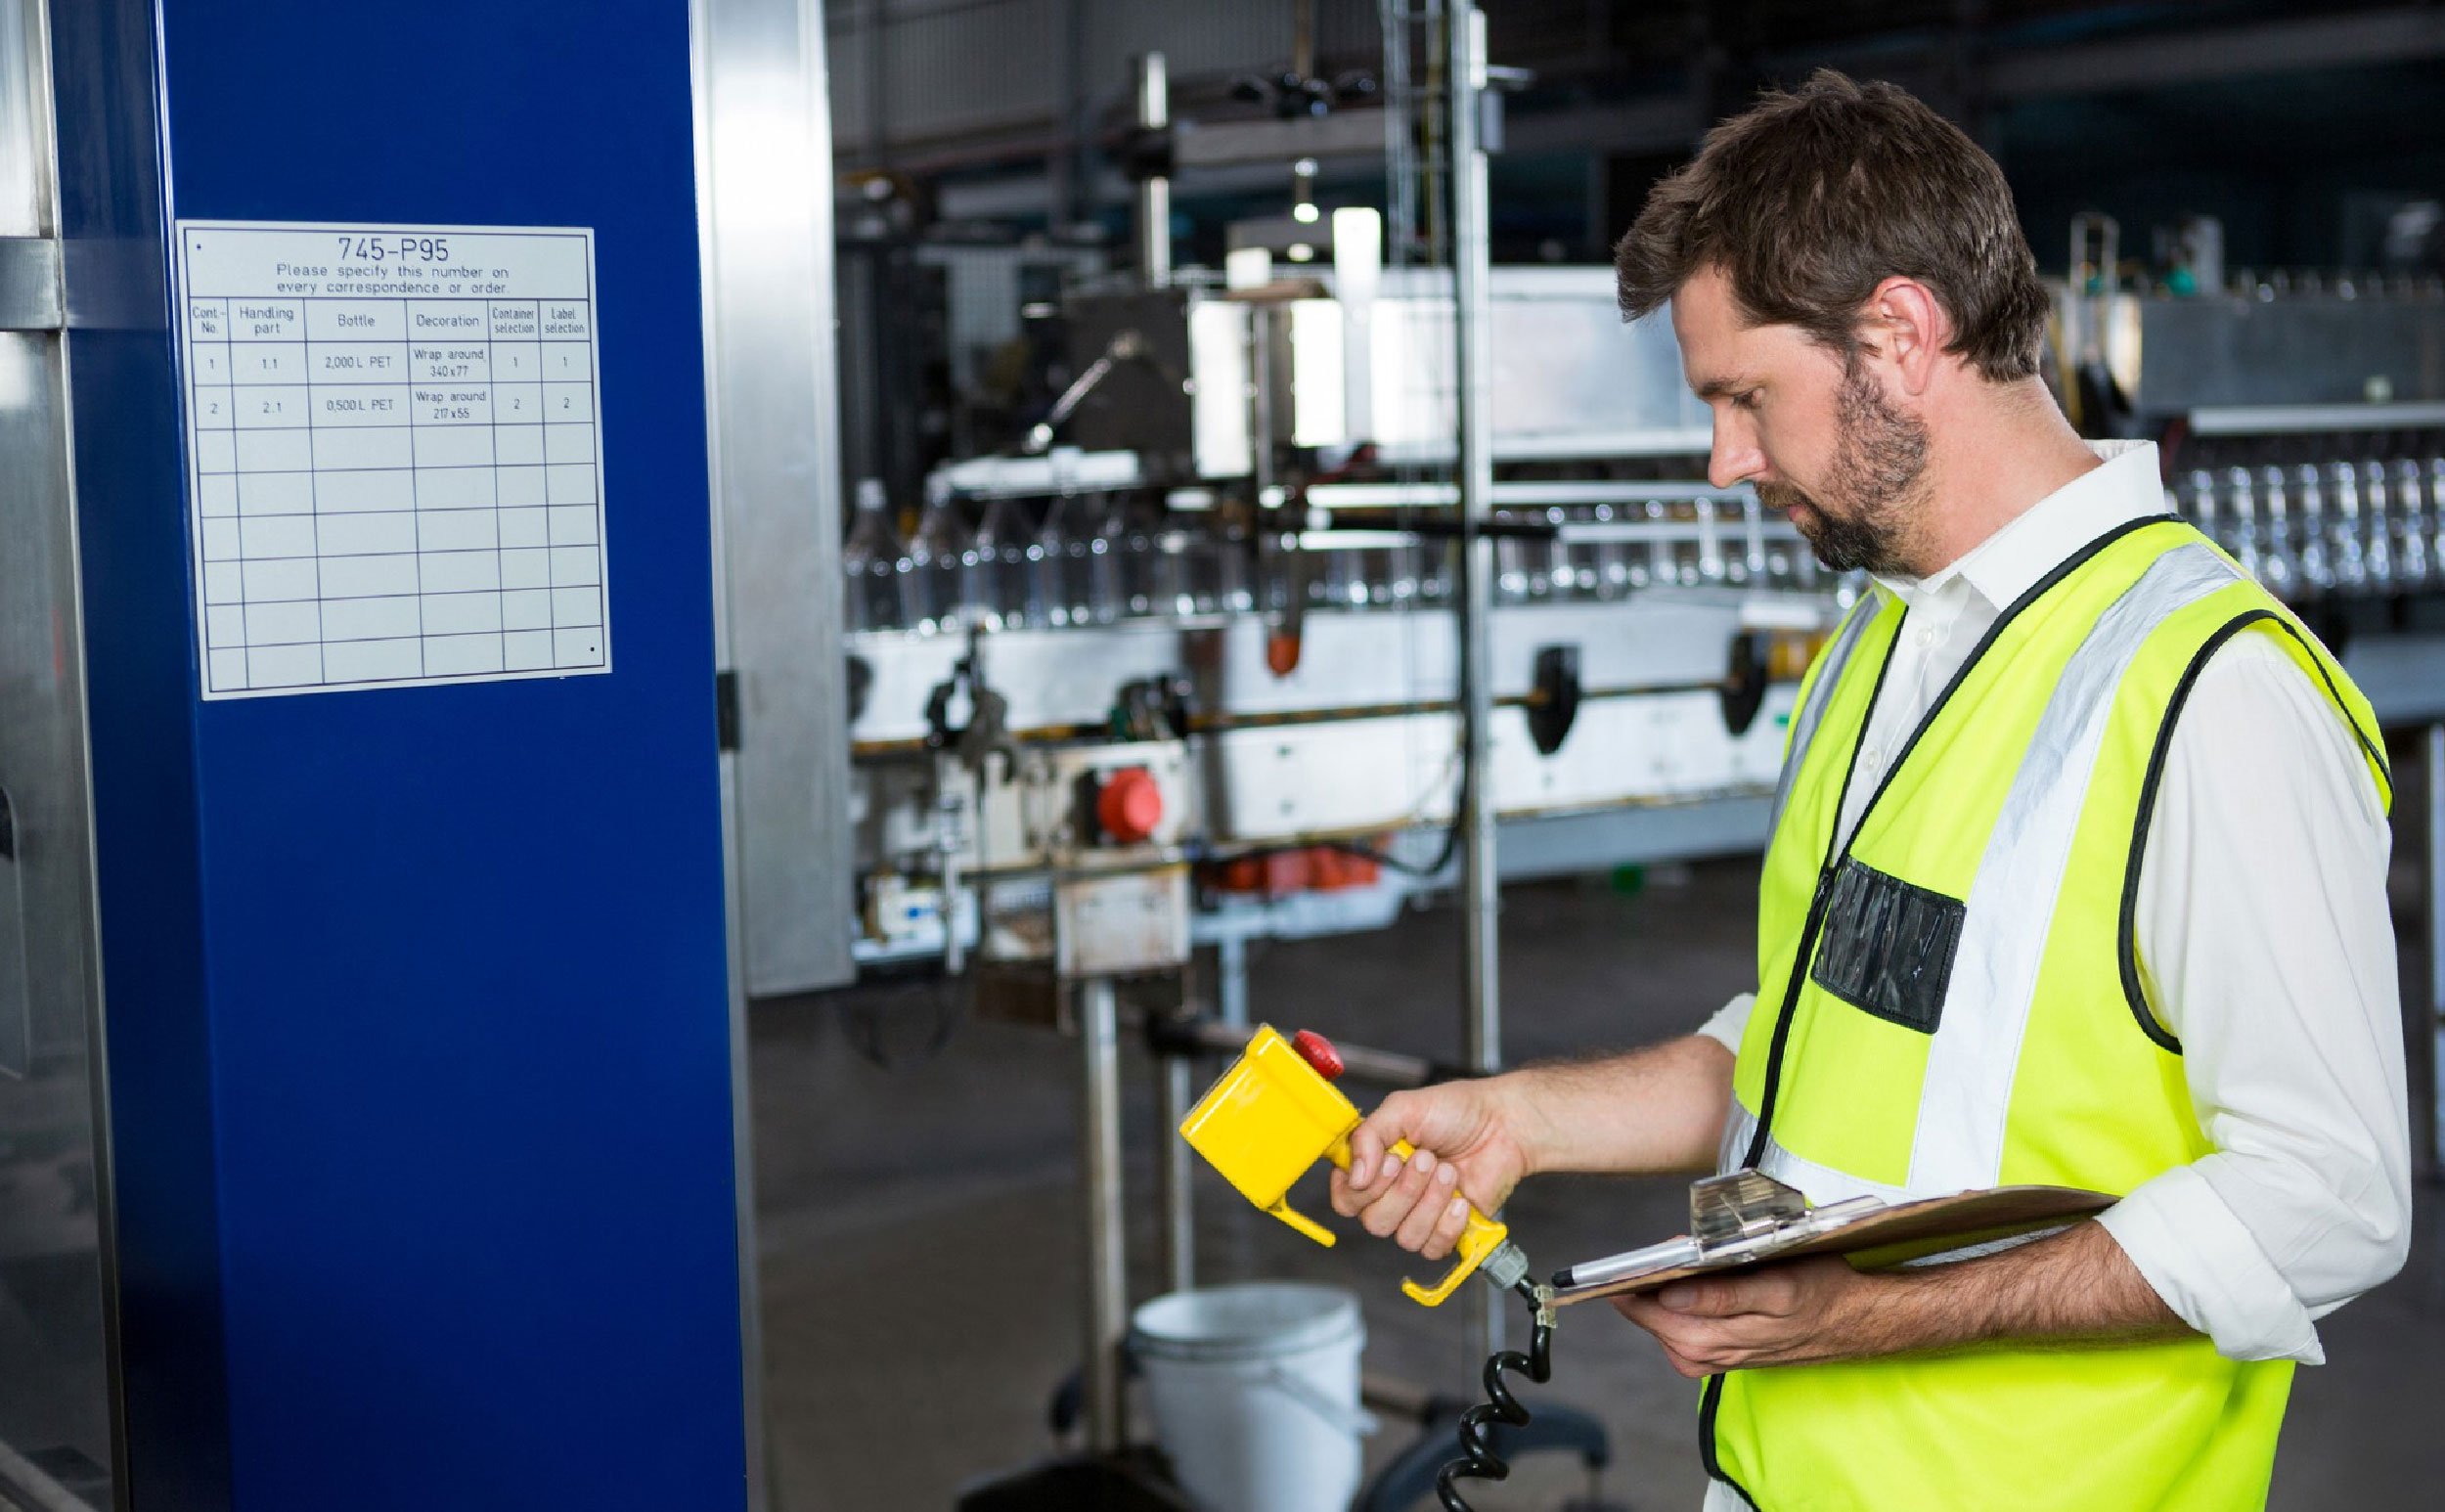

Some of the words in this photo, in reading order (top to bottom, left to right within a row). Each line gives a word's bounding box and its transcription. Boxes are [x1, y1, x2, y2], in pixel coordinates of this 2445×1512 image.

[339, 238, 448, 261] 745-P95
[277, 263, 328, 276] Please
[337, 265, 387, 279] specify
[398, 265, 422, 278] this
[432, 266, 483, 278] number
[492, 269, 509, 278] on
[278, 283, 317, 294] every
[327, 280, 439, 295] correspondence
[448, 284, 462, 293] or
[240, 306, 293, 321] Handling
[492, 307, 534, 319] Container
[552, 307, 576, 319] Label
[338, 314, 375, 327] Bottle
[417, 314, 479, 327] Decoration
[254, 323, 280, 335] part
[495, 323, 534, 334] selection
[545, 322, 585, 334] selection
[415, 349, 442, 361] Wrap
[208, 358, 215, 371] 1
[263, 359, 277, 369] 1.1
[370, 356, 390, 368] PET
[513, 356, 518, 369] 1
[562, 356, 568, 367] 1
[416, 391, 443, 404] Wrap
[451, 391, 486, 401] around
[563, 396, 570, 410] 2
[209, 402, 219, 415] 2
[263, 402, 281, 413] 2.1
[372, 399, 393, 410] PET
[513, 398, 520, 410] 2
